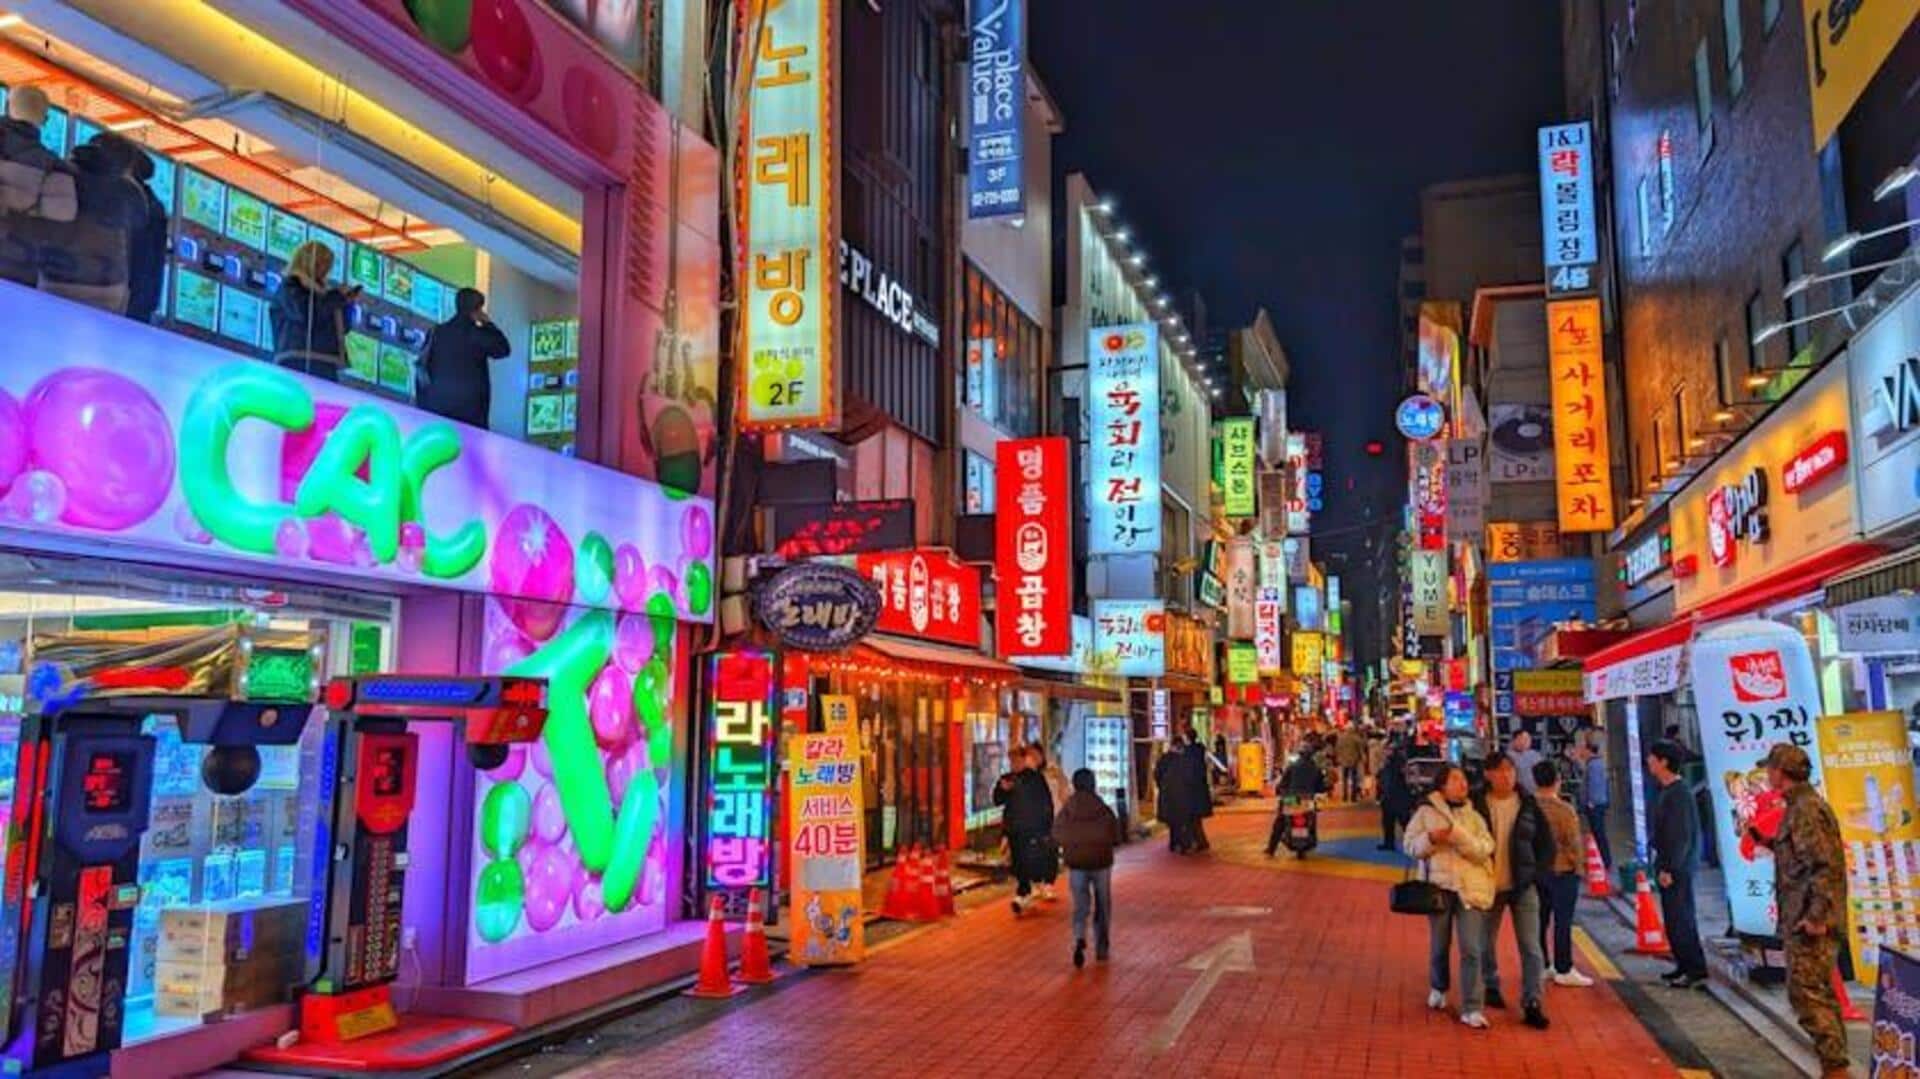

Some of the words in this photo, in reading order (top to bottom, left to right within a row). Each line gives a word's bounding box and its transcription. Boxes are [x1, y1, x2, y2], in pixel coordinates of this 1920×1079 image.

[756, 27, 811, 326] 노래방
[850, 246, 913, 333] PLACE
[769, 381, 804, 406] 2F
[1562, 360, 1604, 520] 사거리포차
[1017, 445, 1044, 515] 명품
[1016, 575, 1048, 648] 곱창
[1424, 554, 1439, 621] YUME
[1722, 704, 1812, 746] 위찜
[795, 763, 856, 786] 노래방
[802, 794, 855, 818] 서비스
[794, 823, 858, 857] 40분
